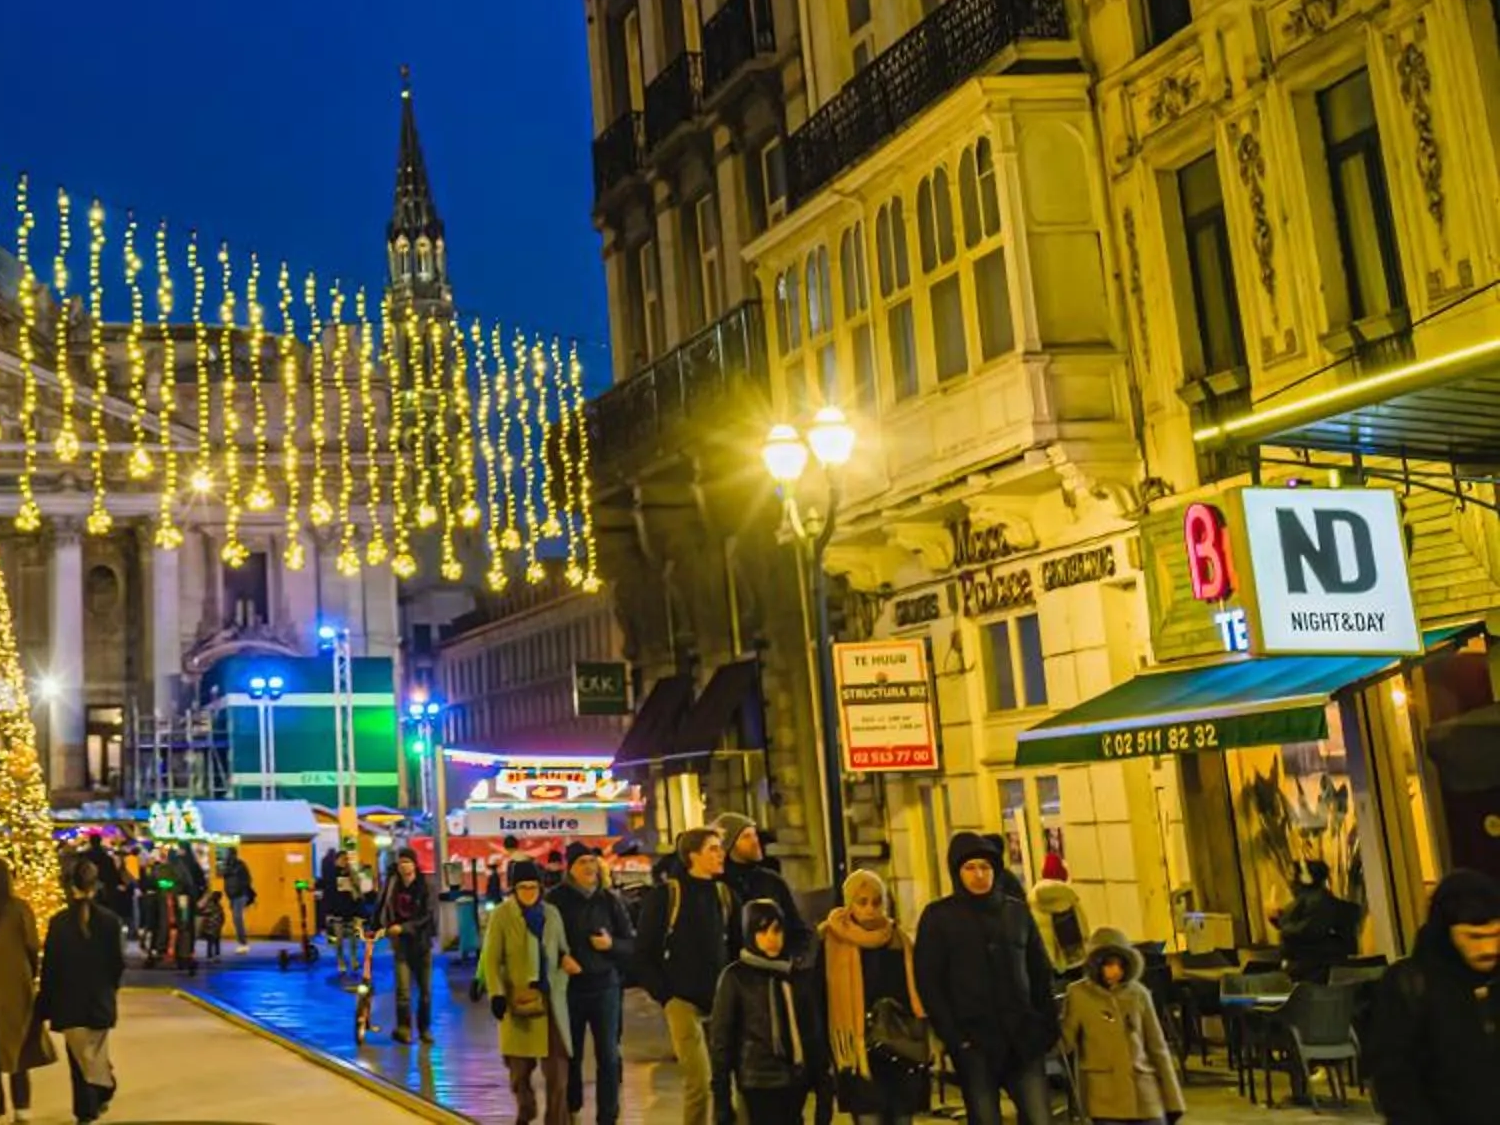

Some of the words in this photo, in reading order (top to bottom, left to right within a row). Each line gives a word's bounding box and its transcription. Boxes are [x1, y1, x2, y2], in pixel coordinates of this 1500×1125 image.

[1275, 506, 1378, 594] ND
[1290, 611, 1386, 632] NIGHT&DAY
[854, 656, 868, 666] TE
[1114, 732, 1133, 756] 02
[1137, 729, 1162, 753] 511
[1167, 726, 1189, 750] 82
[1193, 723, 1219, 748] 32
